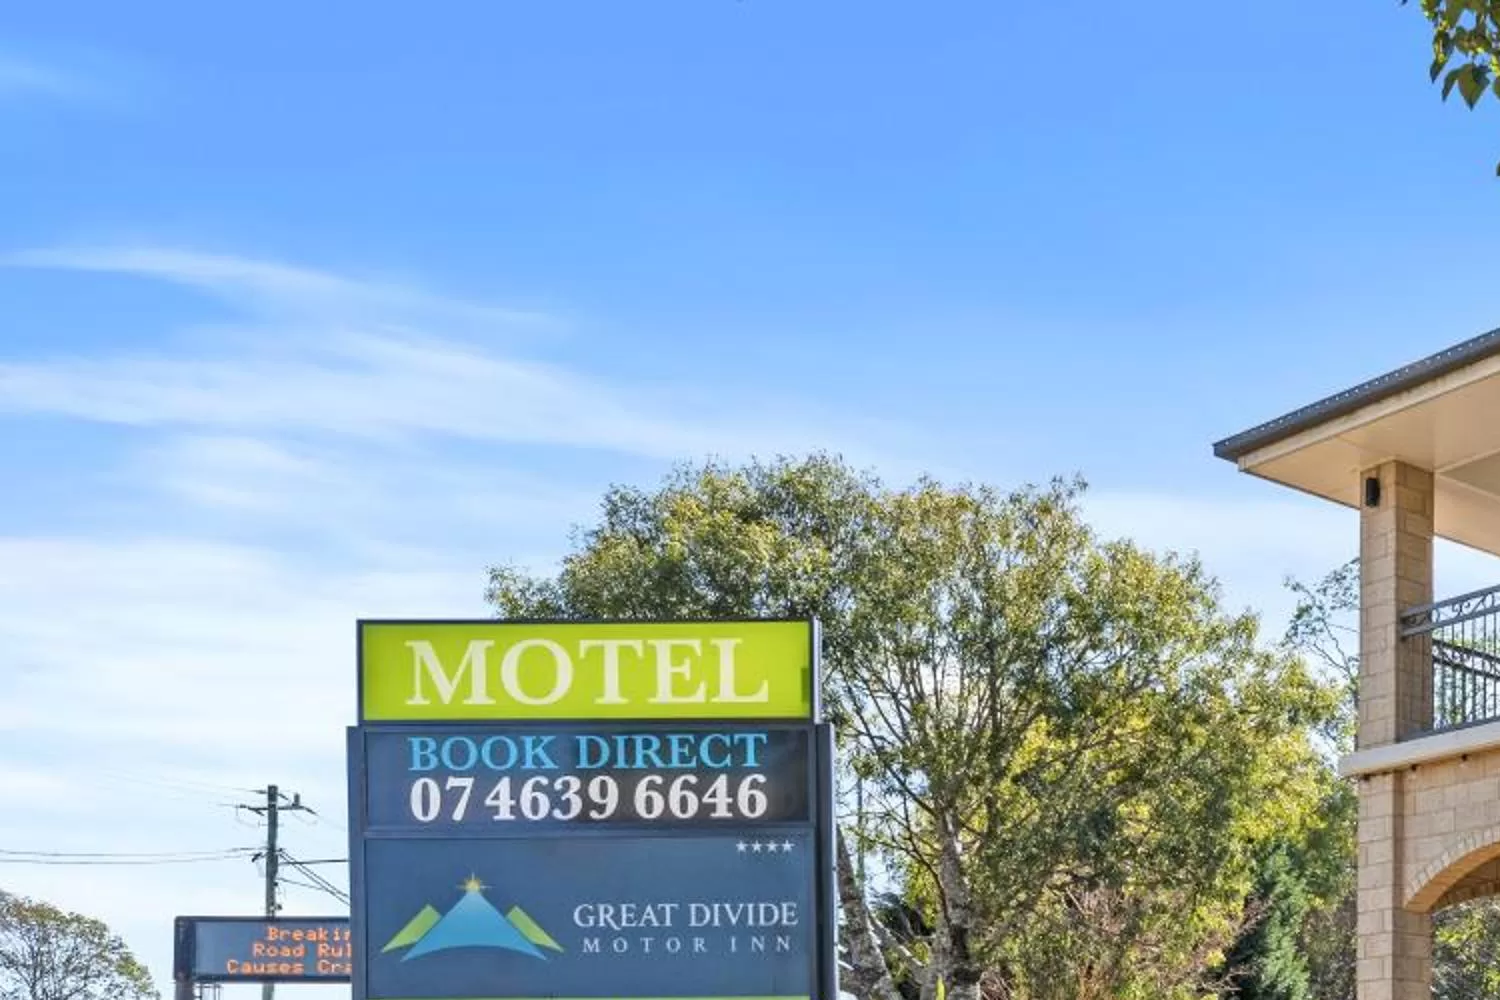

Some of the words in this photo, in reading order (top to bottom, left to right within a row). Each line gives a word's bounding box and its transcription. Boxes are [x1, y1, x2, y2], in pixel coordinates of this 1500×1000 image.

[404, 638, 769, 705] MOTEL
[408, 735, 559, 771] BOOK
[575, 733, 768, 768] DIRECT
[410, 777, 475, 821] 07
[484, 776, 619, 821] 4639
[633, 774, 768, 819] 6646
[573, 902, 679, 930] GREAT
[689, 902, 799, 927] DIVIDE
[254, 943, 305, 957] Road
[582, 936, 707, 953] MOTOR
[730, 937, 791, 952] INN
[226, 960, 304, 974] Causes
